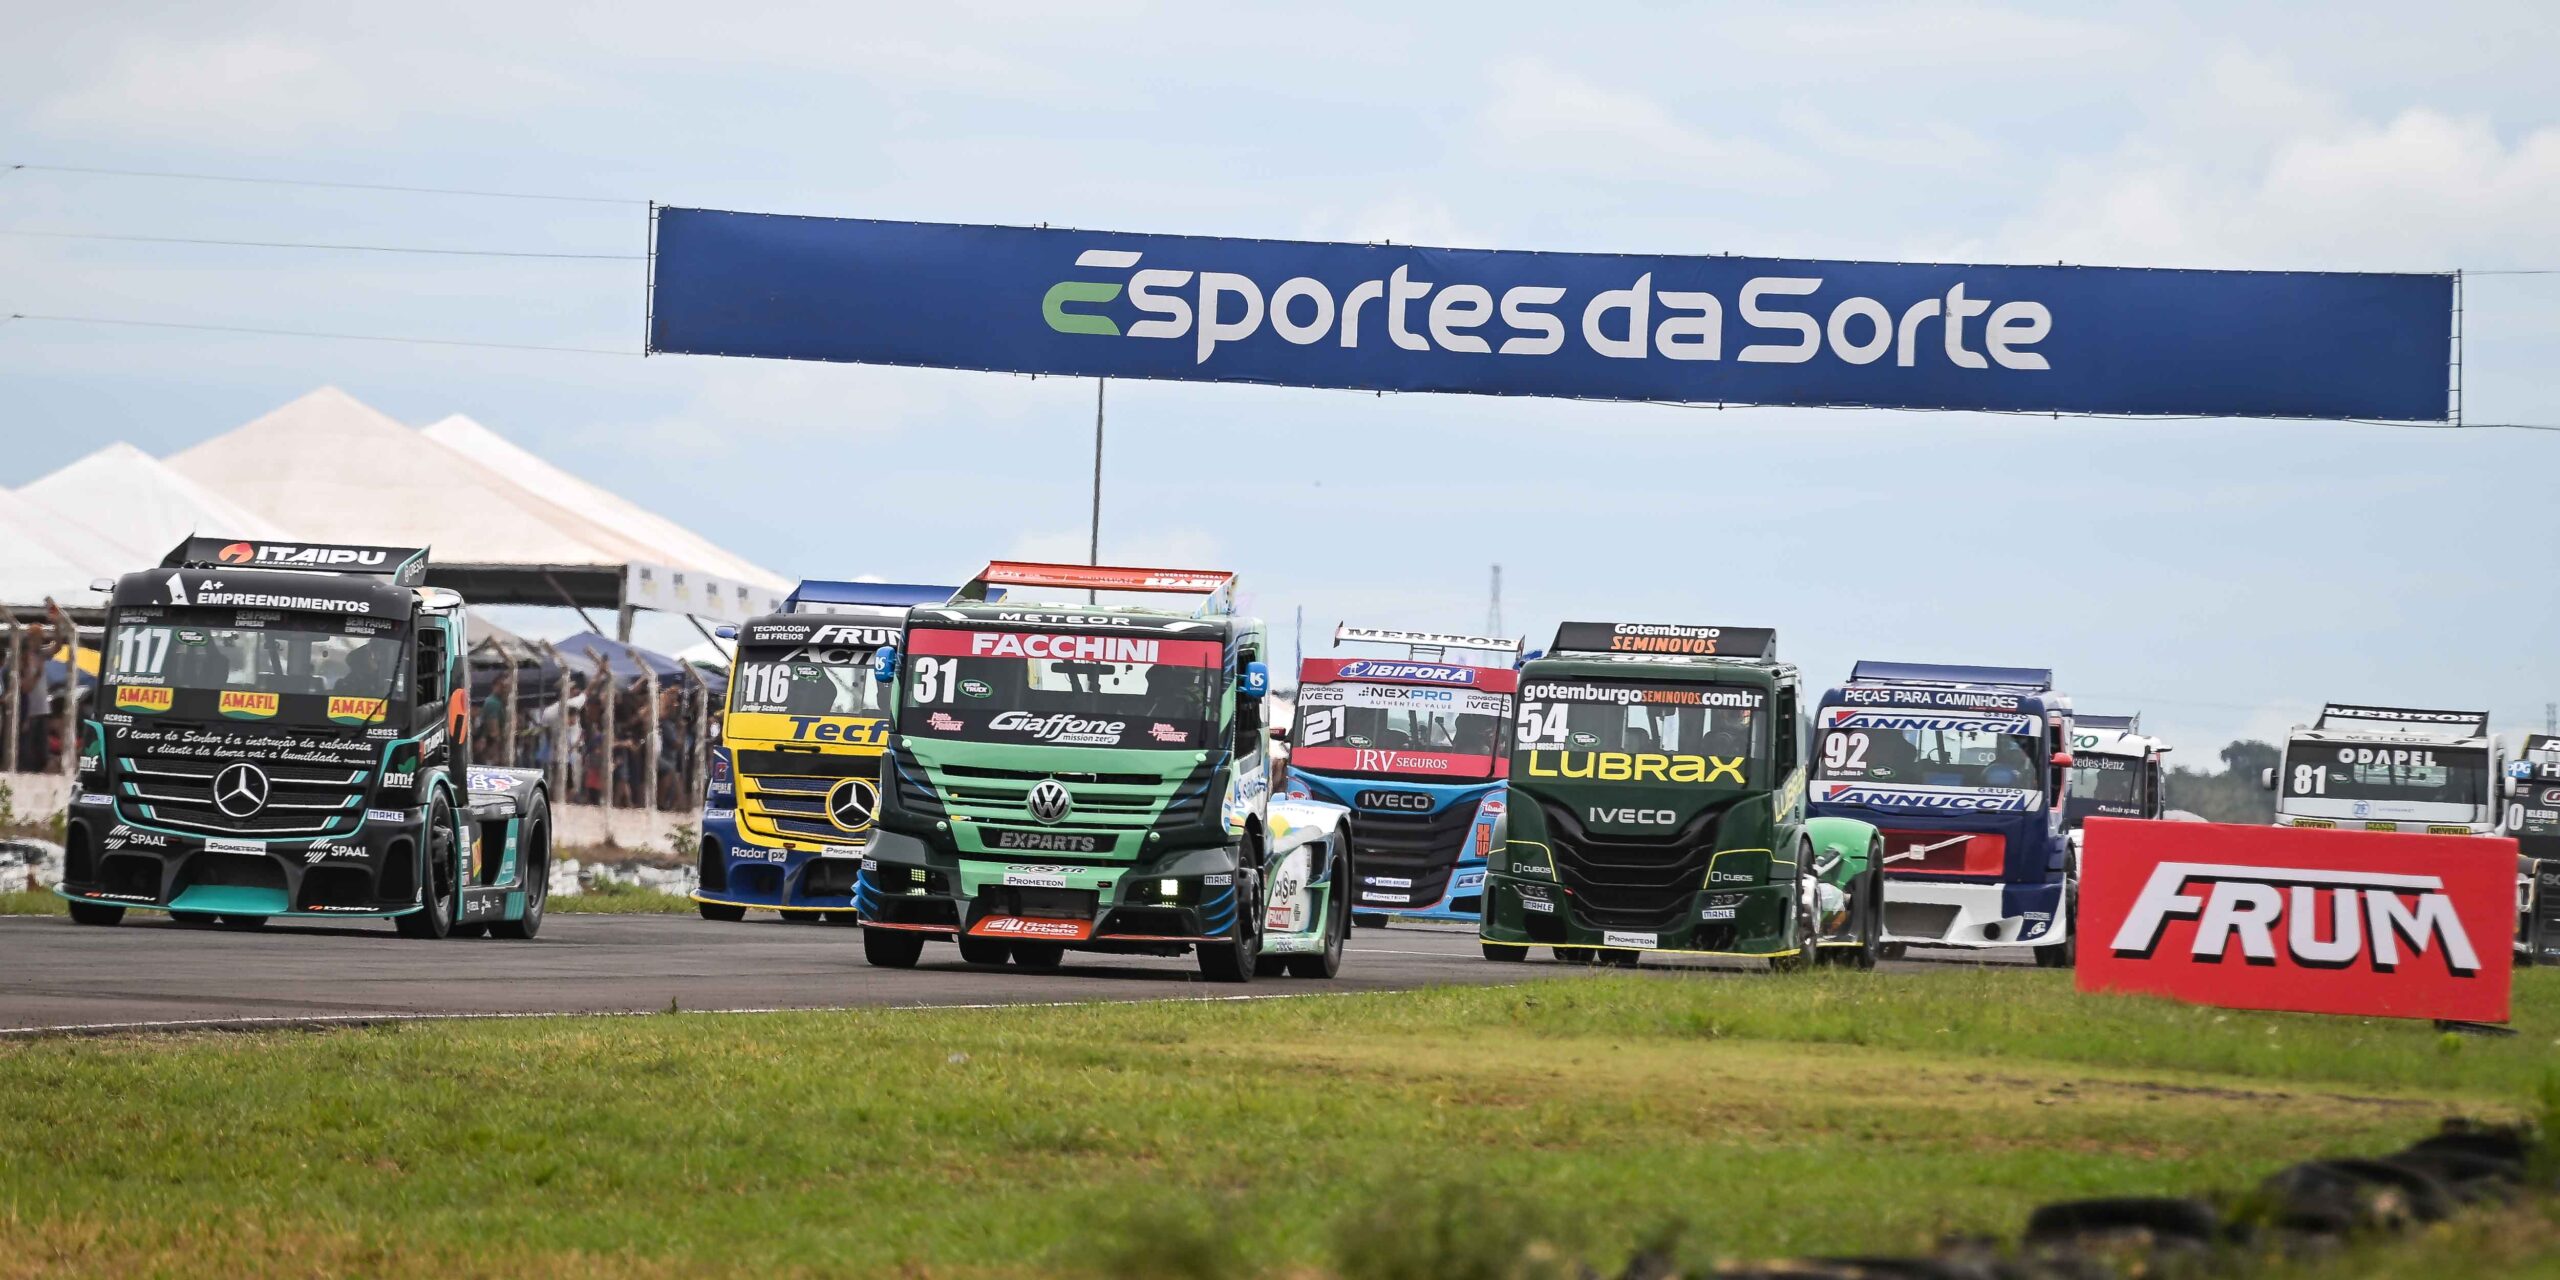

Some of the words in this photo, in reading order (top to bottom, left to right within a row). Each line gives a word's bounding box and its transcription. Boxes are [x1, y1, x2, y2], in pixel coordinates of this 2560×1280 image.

[1045, 250, 1567, 364] Esportes
[1586, 273, 1721, 360] da
[1739, 277, 2051, 370] Sorte
[257, 546, 386, 566] ITAIPU
[199, 580, 224, 591] A+
[197, 593, 370, 613] EMPREENDIMENTOS
[999, 612, 1130, 625] METEOR
[753, 626, 811, 636] TECNOLOGIA
[756, 633, 776, 642] EM
[777, 632, 804, 643] FREIOS
[1348, 628, 1514, 647] MERITOR
[1614, 623, 1720, 643] Gotemburgo
[118, 628, 172, 673] 117
[971, 633, 1159, 663] FACCHINI
[1610, 636, 1717, 654] SEMINOVOS
[744, 662, 790, 704] 116
[913, 657, 957, 703] 31
[119, 691, 170, 706] AMAFIL
[222, 694, 276, 711] AMAFIL
[1301, 692, 1344, 701] IVECO
[1371, 687, 1453, 701] NEXPRO
[1845, 690, 1890, 707] PEÇAS
[1894, 691, 1931, 704] PARA
[331, 699, 386, 718] AMAFIL
[1466, 701, 1510, 712] IVECO
[2324, 707, 2480, 723] MERITOR
[989, 711, 1126, 742] Giaffone
[1304, 706, 1345, 747] 21
[1518, 703, 1569, 743] 54
[117, 727, 127, 738] O
[131, 730, 160, 740] temor
[164, 731, 178, 741] do
[182, 730, 222, 744] Senhor
[233, 736, 243, 744] a
[245, 734, 297, 749] instrução
[300, 737, 316, 748] da
[319, 737, 373, 751] sabedoria
[367, 729, 398, 738] ACROSS
[1062, 734, 1093, 742] mission
[157, 743, 191, 755] diante
[195, 745, 210, 756] da
[213, 745, 245, 758] honra
[248, 749, 264, 758] vai
[269, 750, 278, 758] a
[1825, 732, 1870, 768] 92
[2337, 748, 2437, 768] ODAPEL
[1354, 749, 1397, 772] JRV
[1396, 757, 1449, 771] SEGUROS
[2294, 765, 2326, 795] 81
[1977, 787, 2023, 796] GRUPO
[1364, 793, 1428, 809] IVECO
[369, 811, 402, 821] MAHLE
[1590, 806, 1676, 825] IVECO
[130, 834, 167, 847] SPAAL
[1000, 832, 1096, 852] EXPARTS
[331, 845, 369, 858] SPAAL
[732, 847, 767, 860] Radar
[771, 850, 785, 863] px
[1523, 865, 1552, 874] CUBOS
[1723, 873, 1753, 882] CUBOS
[1007, 876, 1064, 887] PROMETEON
[2109, 861, 2482, 976] FRUM
[1607, 934, 1655, 945] PROMETEON
